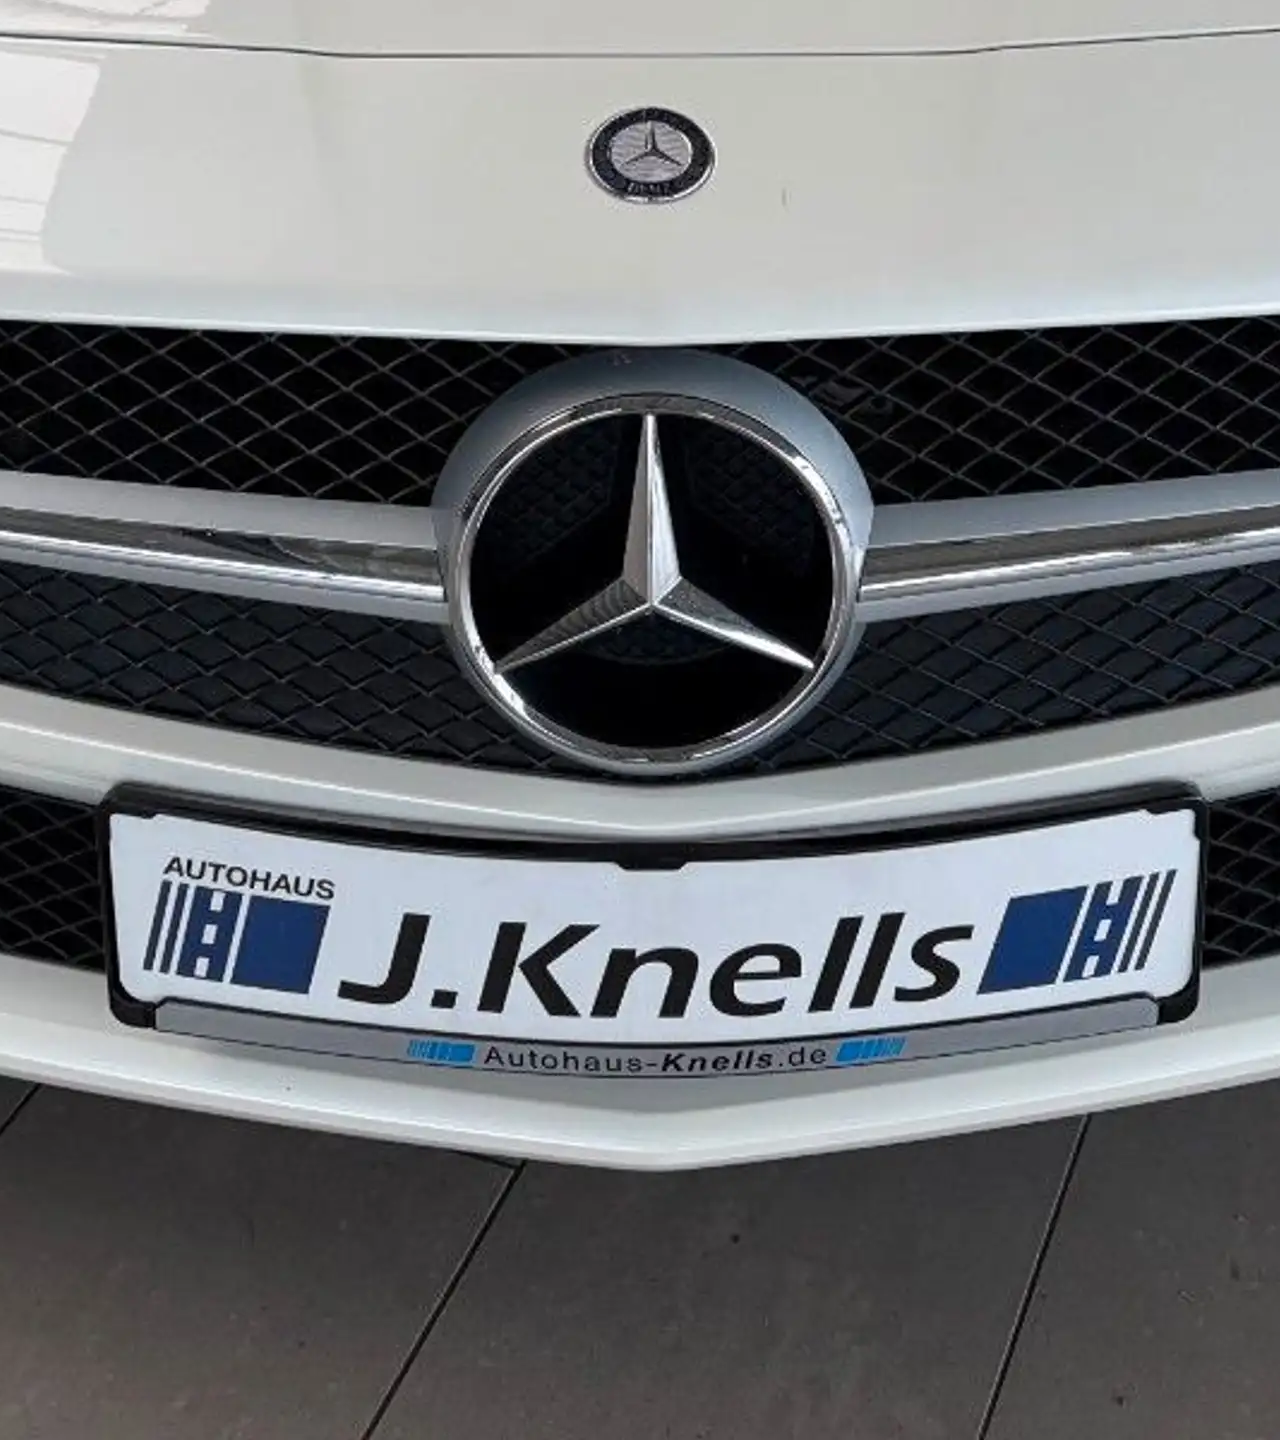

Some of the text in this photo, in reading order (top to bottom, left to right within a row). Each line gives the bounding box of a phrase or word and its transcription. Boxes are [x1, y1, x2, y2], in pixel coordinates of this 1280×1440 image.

[163, 856, 336, 900] AUTOHAUS
[337, 912, 974, 1018] J.Knells
[483, 1046, 826, 1073] Autohaus-Knells.de
